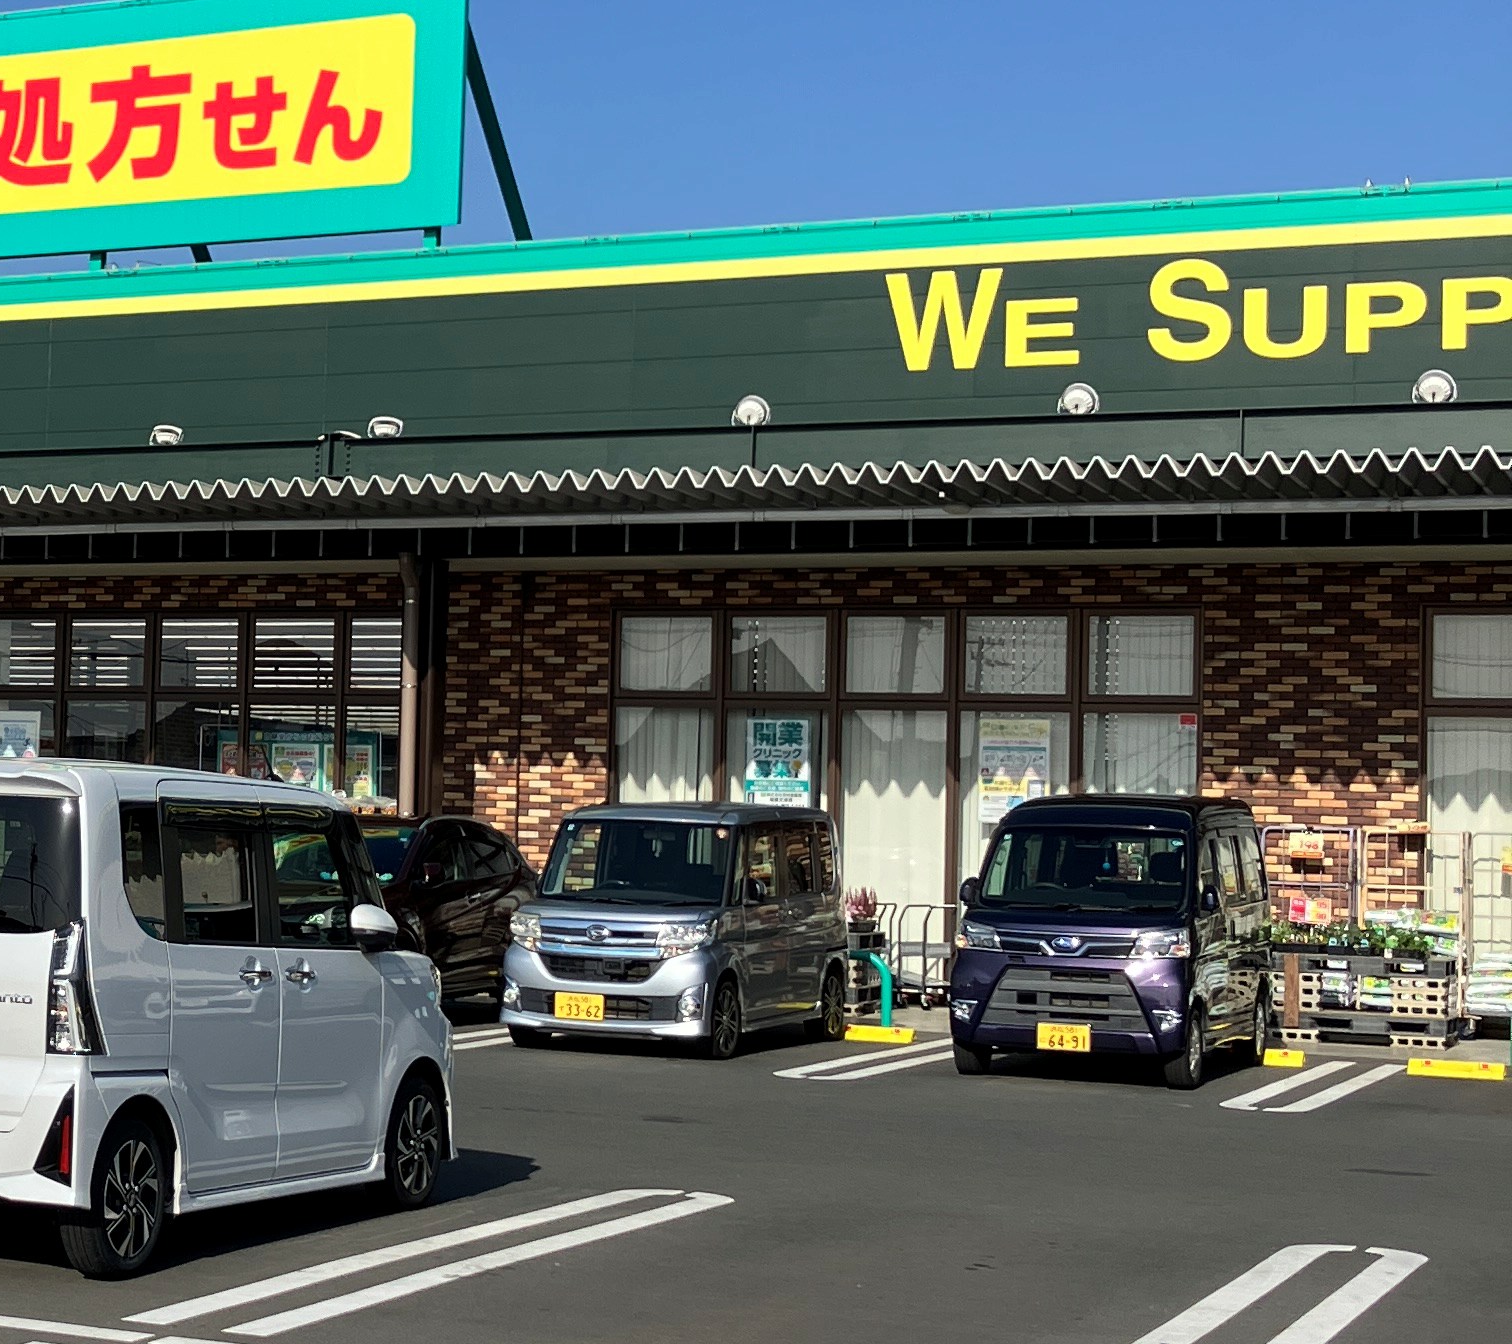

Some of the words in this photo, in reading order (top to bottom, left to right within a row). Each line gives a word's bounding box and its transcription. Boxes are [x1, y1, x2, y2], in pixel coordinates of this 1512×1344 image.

[753, 722, 804, 747] 開業
[753, 748, 803, 759] クリニック
